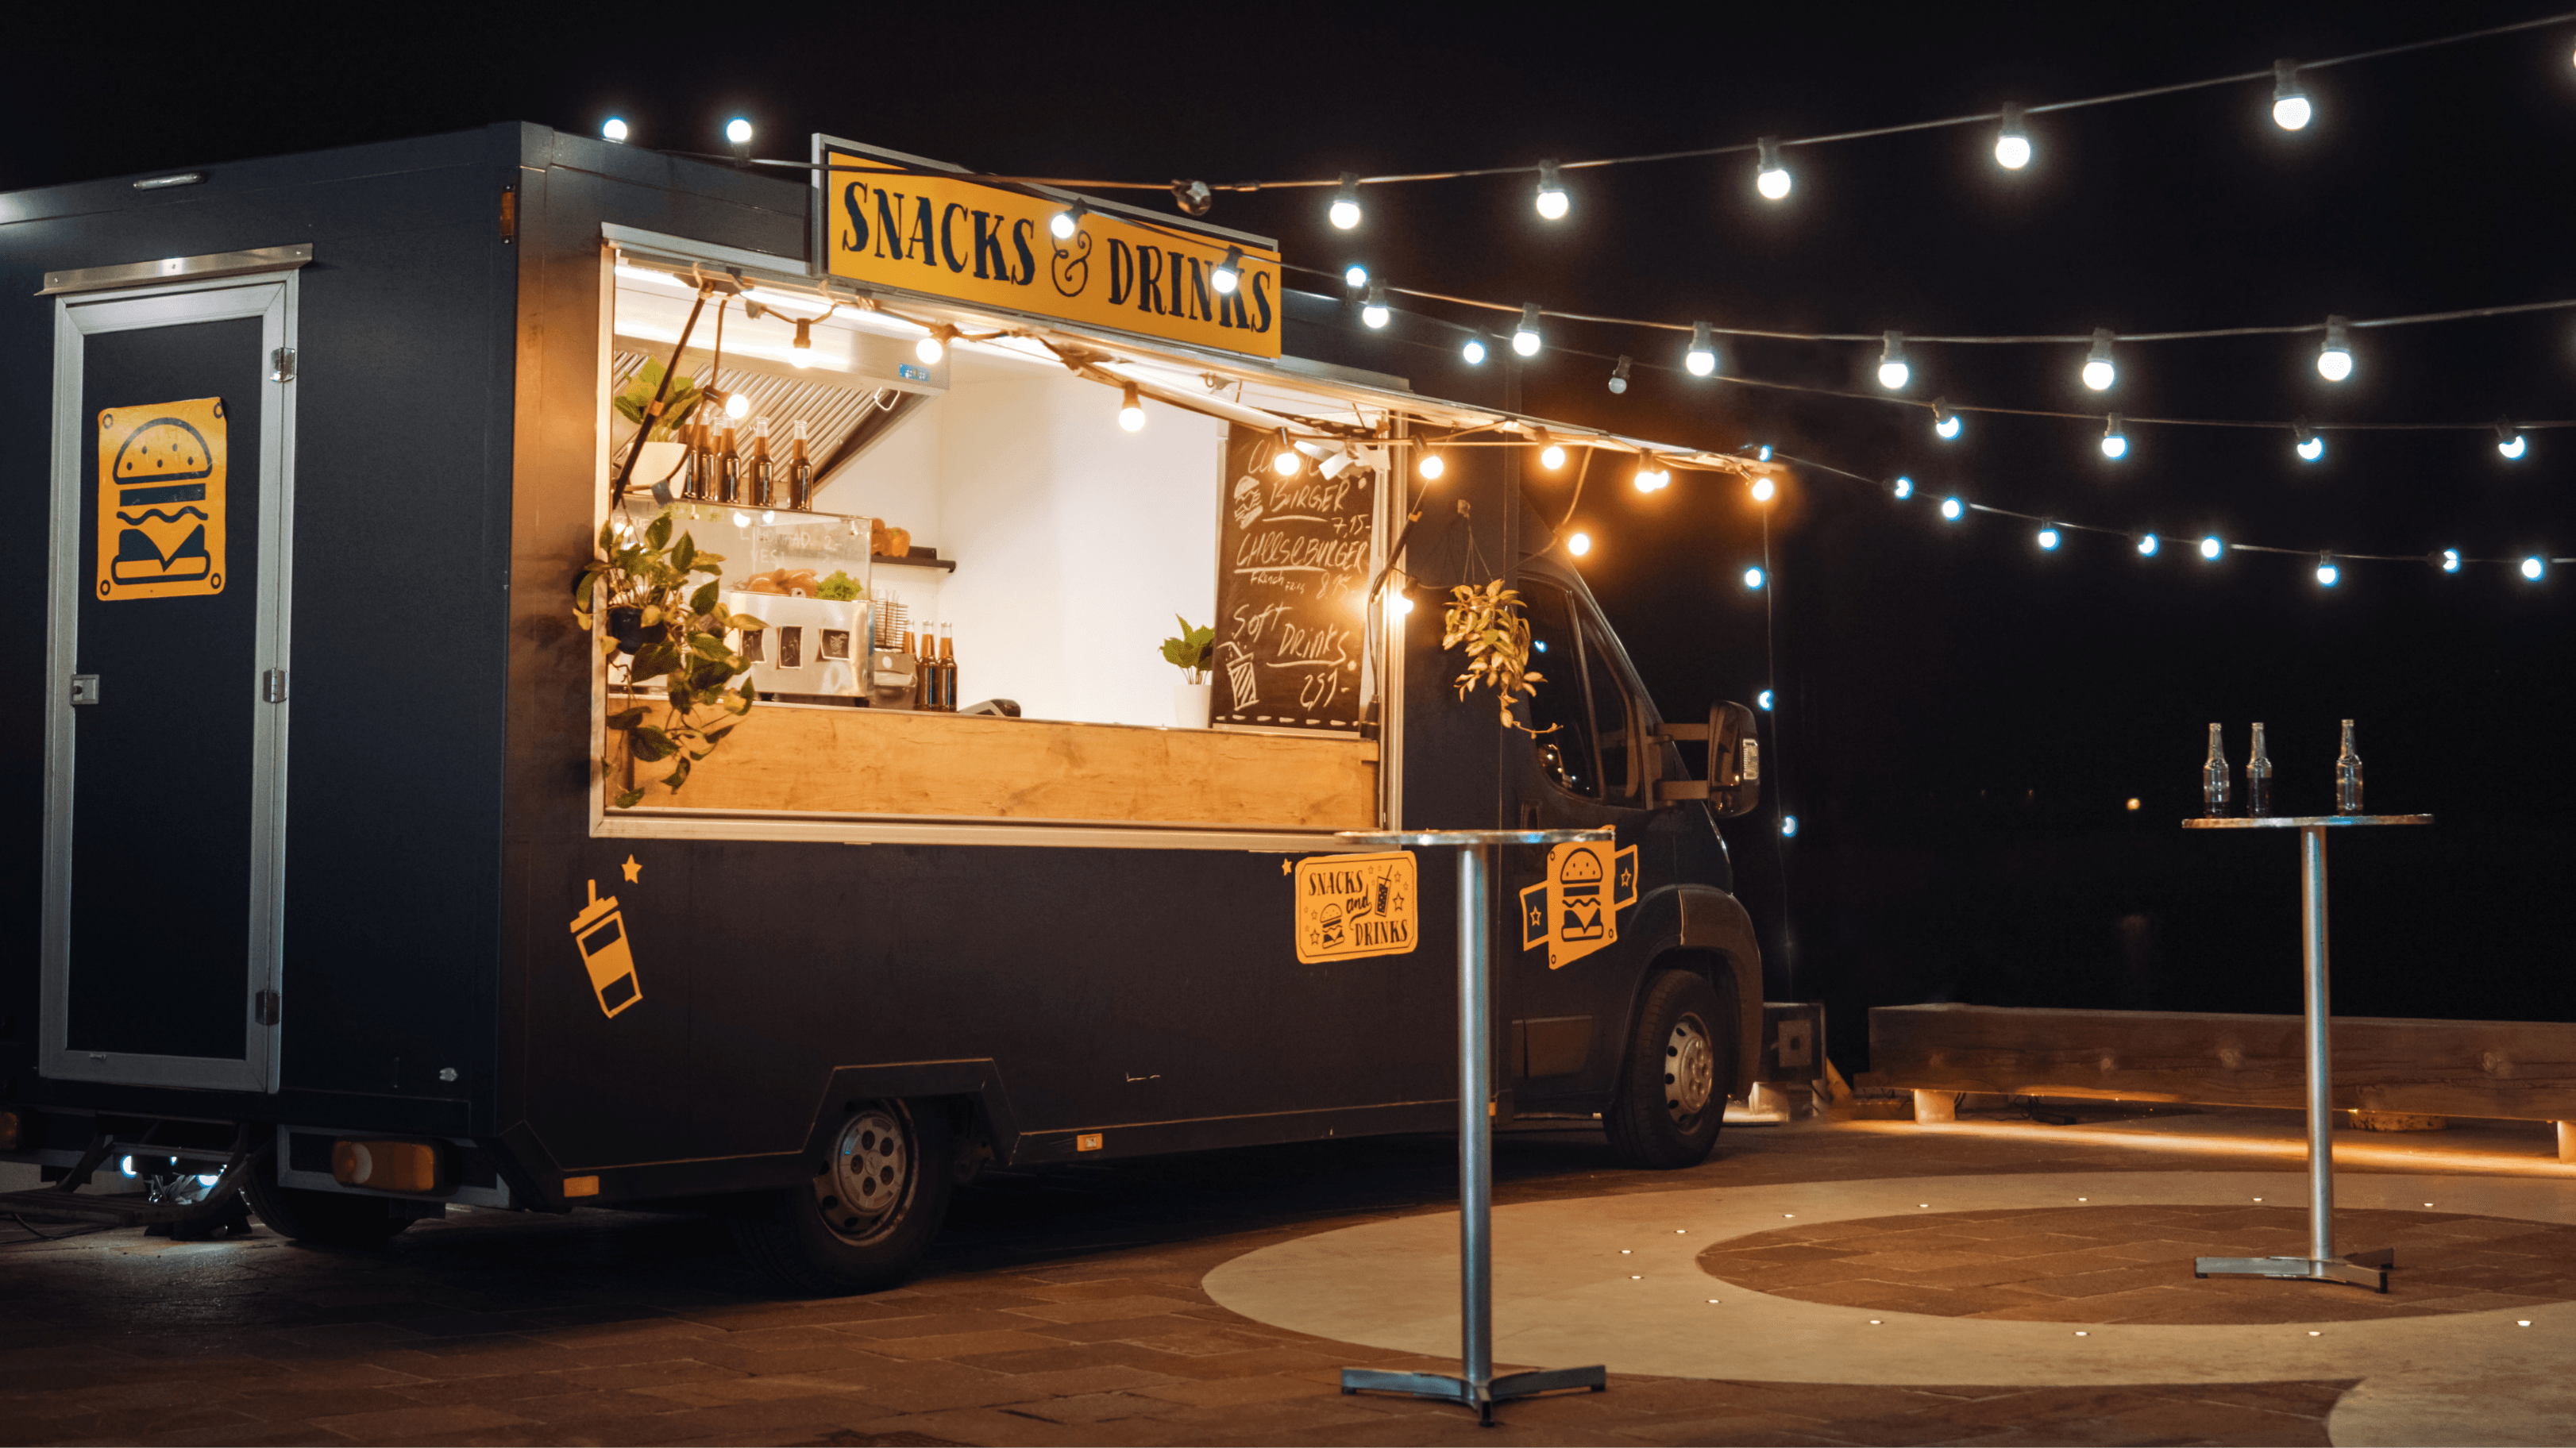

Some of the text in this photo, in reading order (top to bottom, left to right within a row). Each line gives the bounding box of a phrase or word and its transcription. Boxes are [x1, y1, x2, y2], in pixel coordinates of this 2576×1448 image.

[843, 182, 1272, 333] SNACKS & DRINKS
[1309, 869, 1363, 896] SNACKS
[1346, 883, 1371, 915] and
[1355, 918, 1408, 946] DRINKS
